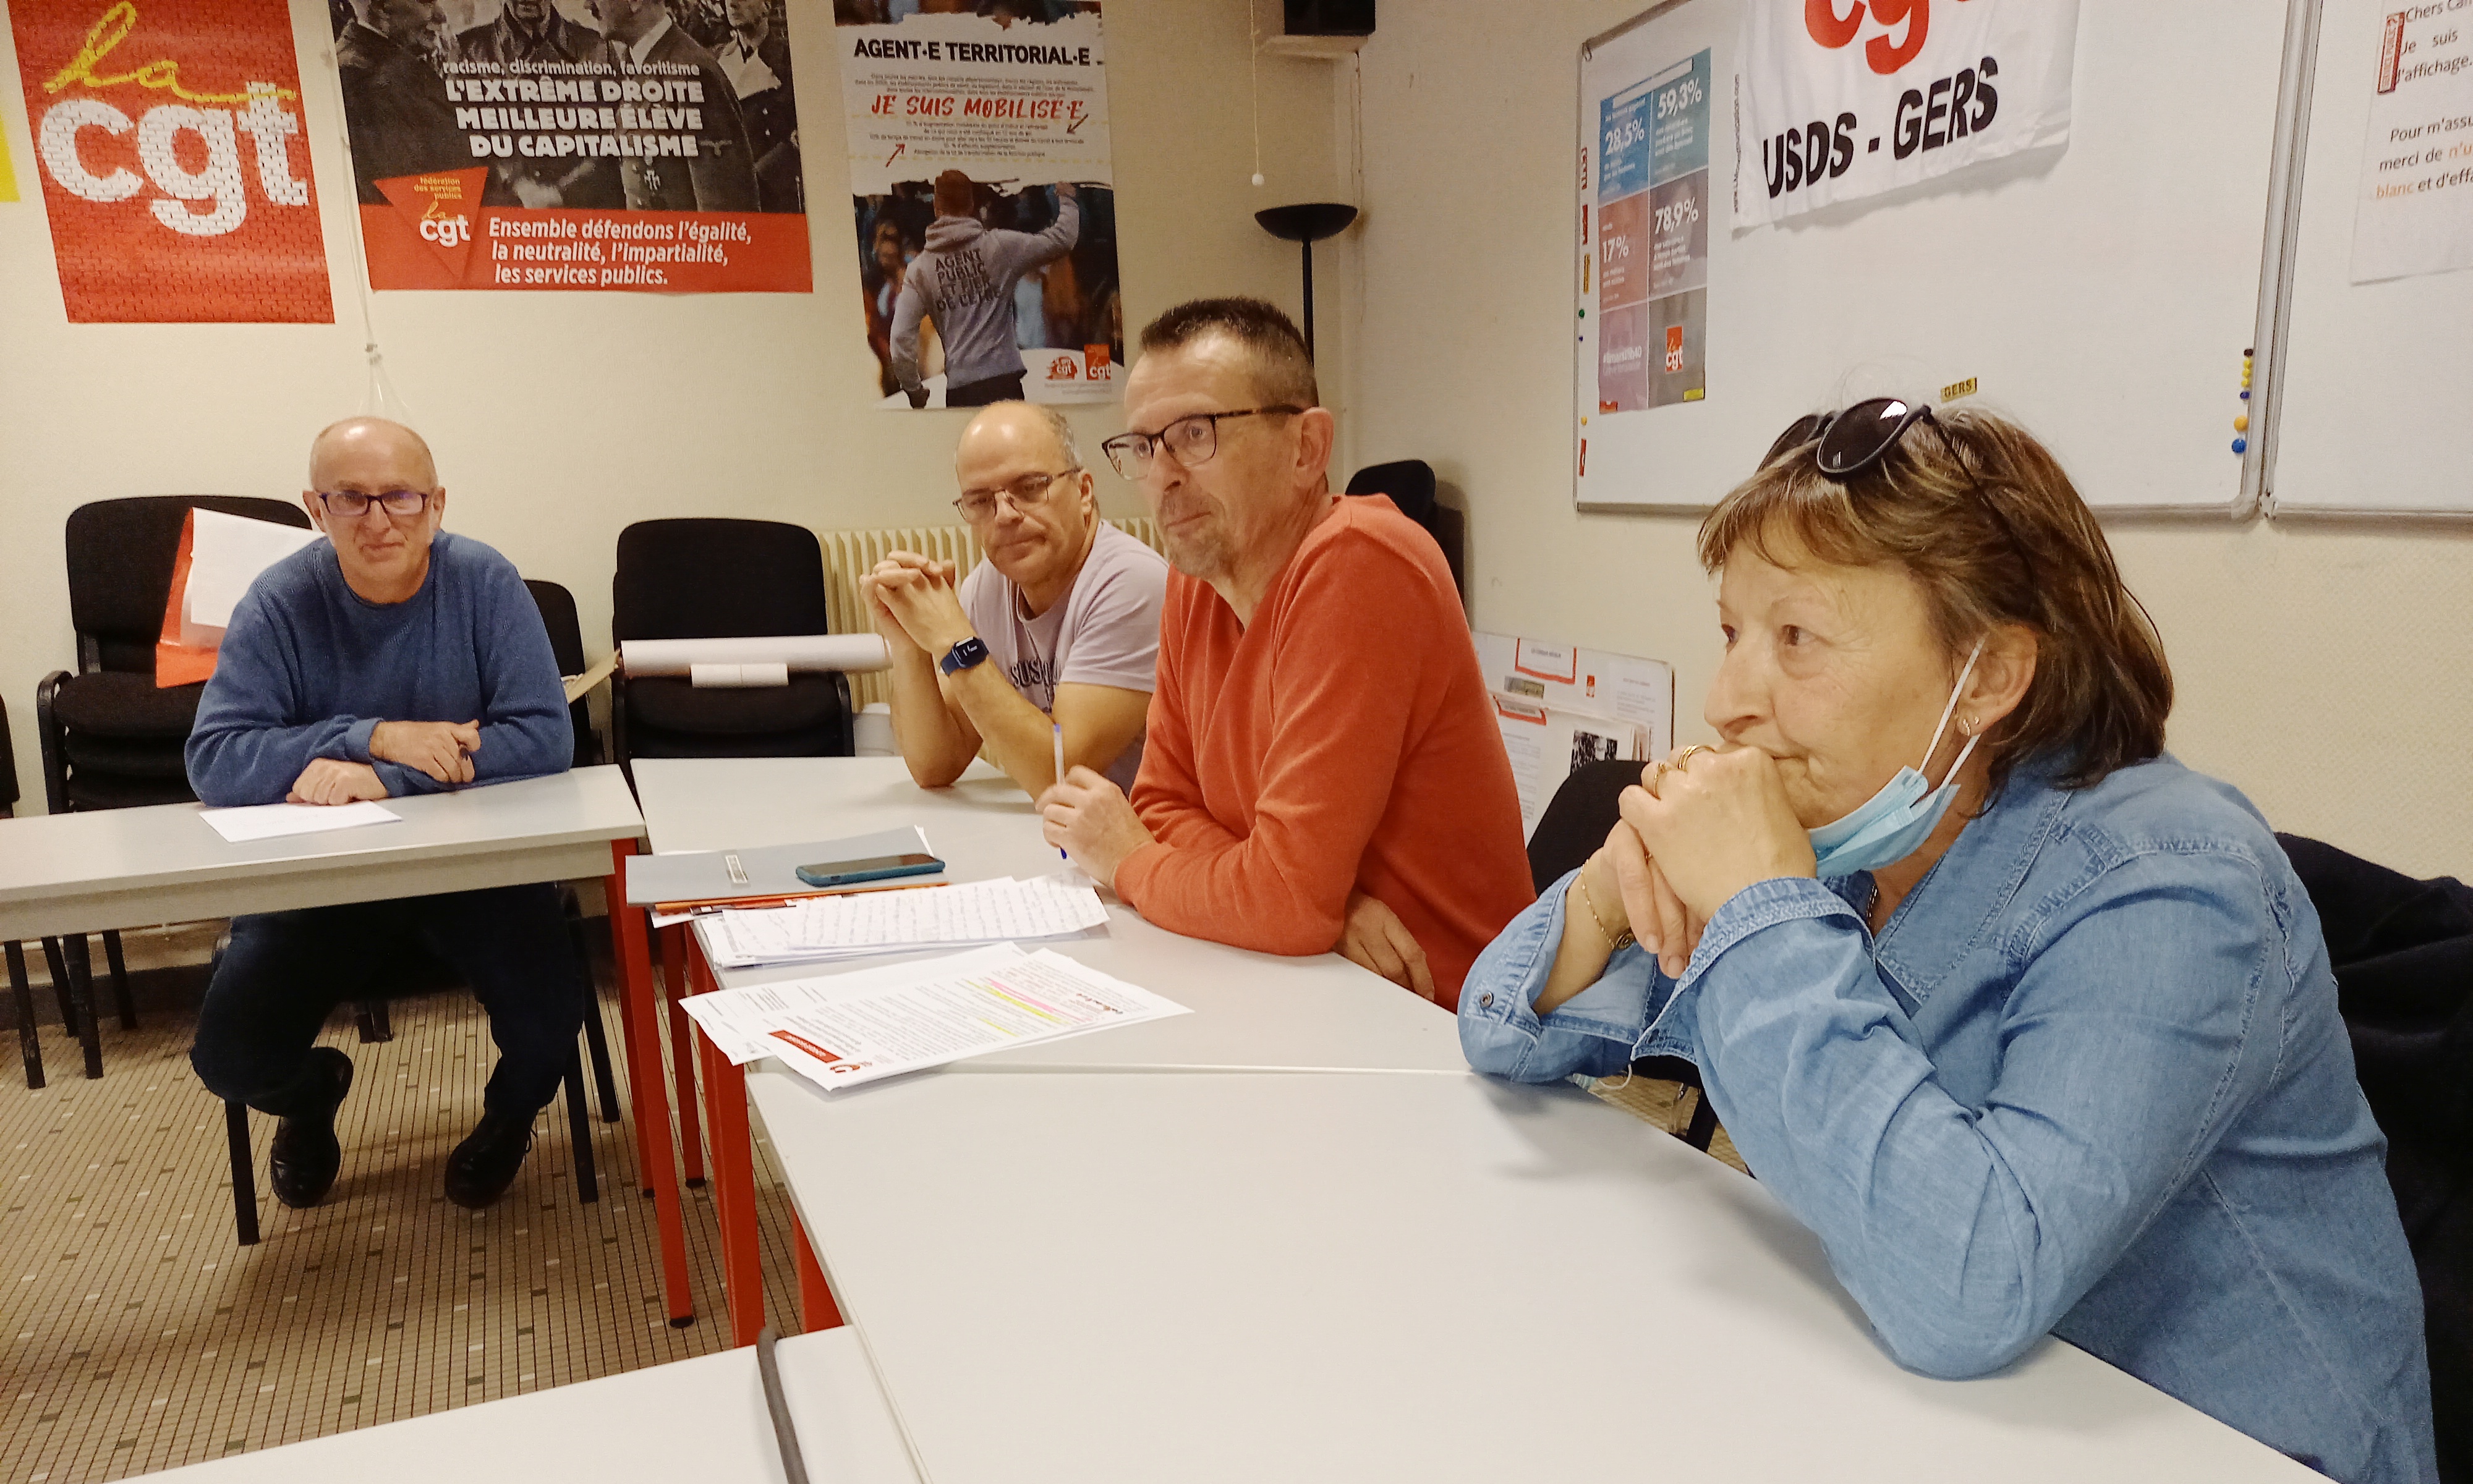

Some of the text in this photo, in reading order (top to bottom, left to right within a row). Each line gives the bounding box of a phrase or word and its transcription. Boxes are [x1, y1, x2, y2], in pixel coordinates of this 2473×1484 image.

[2406, 2, 2443, 23] Chers
[1804, 0, 1972, 75] cg
[2401, 28, 2458, 56] Je suis
[442, 59, 700, 76] racisme, discrimination, favoritisme
[445, 75, 705, 103] L'EXTRÊME DROITE
[1657, 77, 1702, 119] 59,3%
[455, 103, 703, 130] MEILLEURE ÉLÈVE
[871, 95, 896, 115] JE
[906, 96, 955, 116] SUIS
[1605, 117, 1645, 155] 28,5%
[1763, 112, 1857, 199] USDS
[1893, 56, 1998, 160] GERS
[2391, 126, 2423, 142] Pour
[40, 81, 310, 237] cgt
[469, 134, 699, 158] DU CAPITALISME
[2380, 151, 2419, 171] merci
[2425, 147, 2443, 163] de
[2377, 182, 2414, 199] blanc
[2418, 177, 2431, 192] et
[1654, 197, 1699, 234] 78,9%
[420, 214, 470, 247] cgt
[489, 217, 752, 245] Ensemble défendons l'égalité,
[492, 240, 728, 266] la neutralité, l'impartialité,
[1603, 234, 1629, 263] 17%
[495, 264, 668, 287] les services publics.
[1666, 345, 1683, 371] cgt
[1944, 378, 1971, 398] GERS
